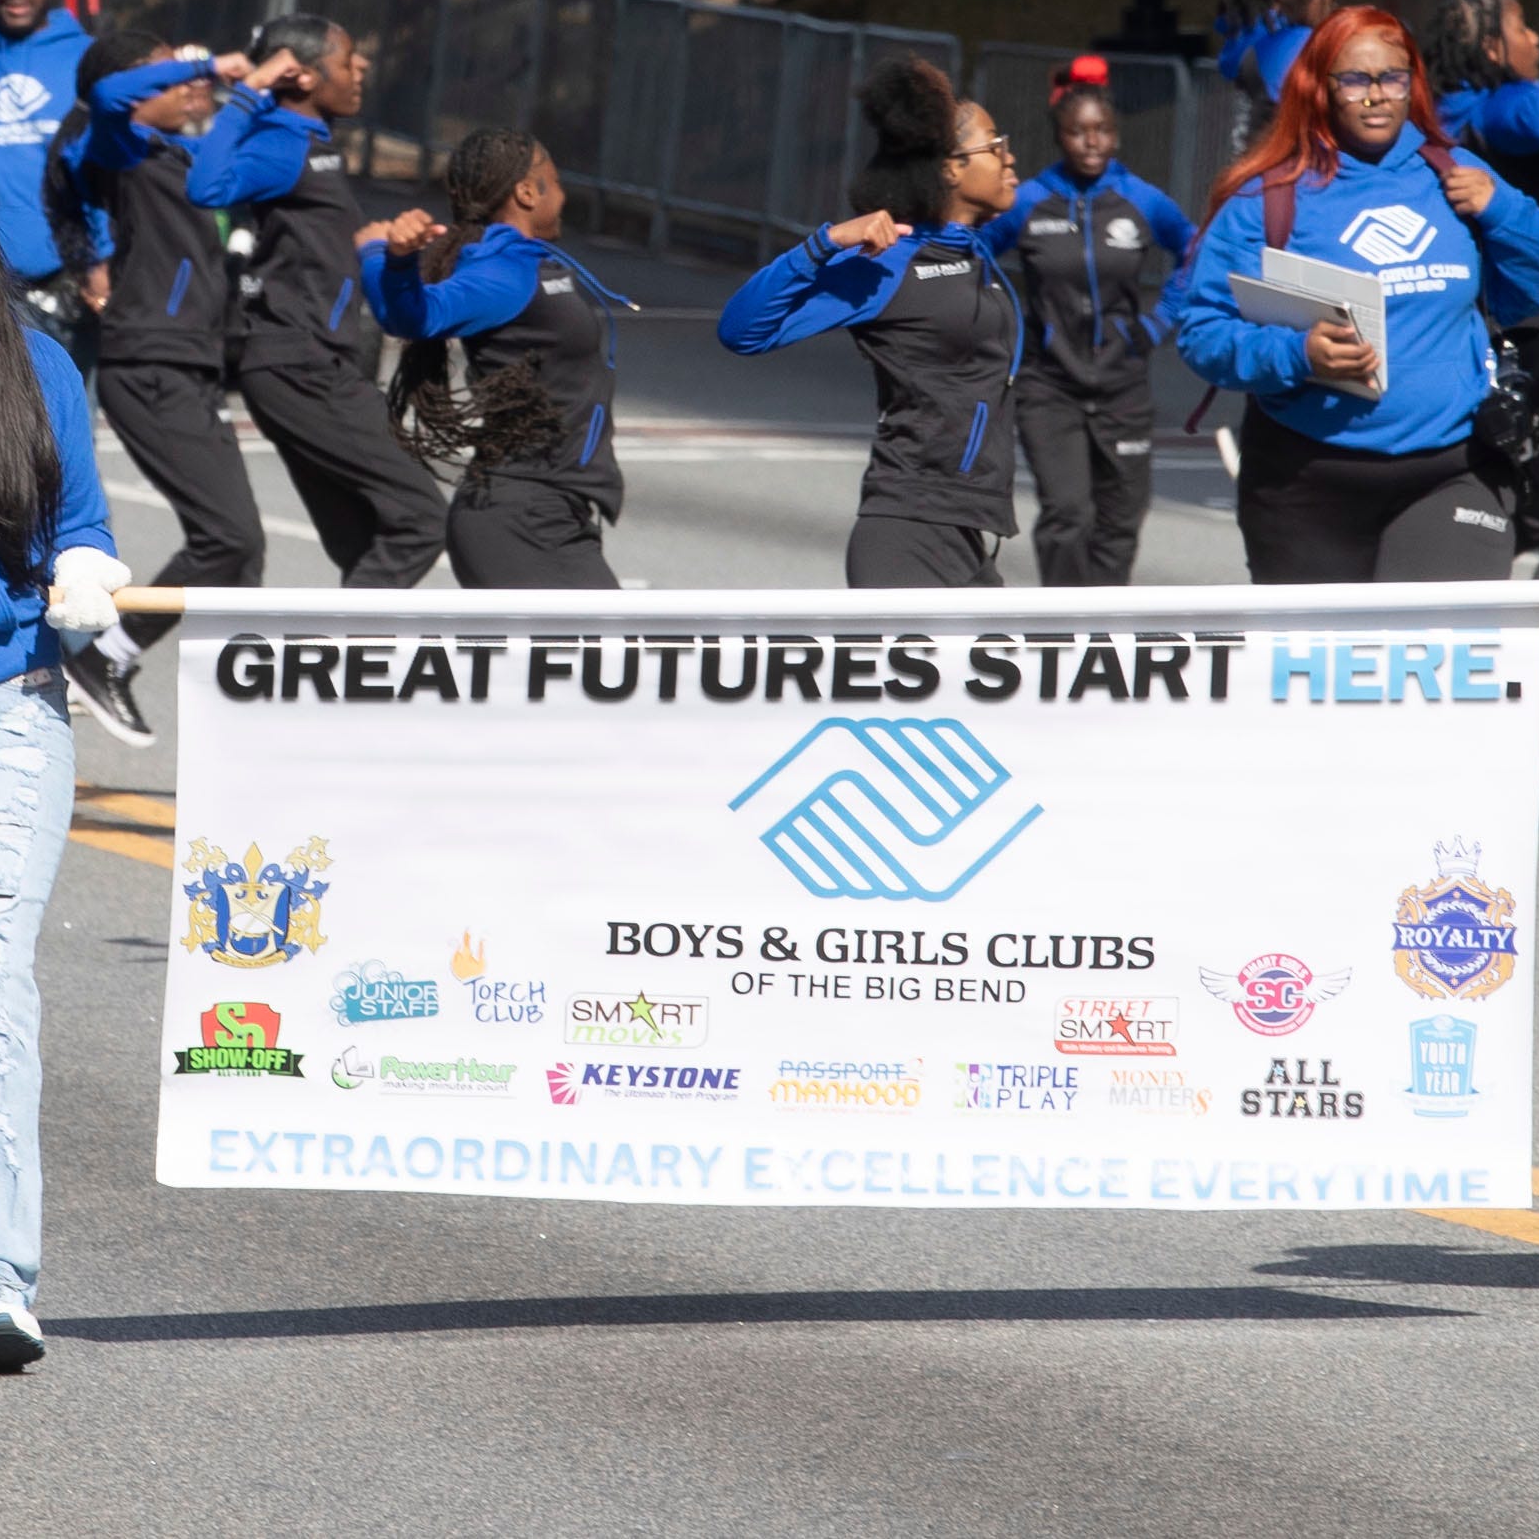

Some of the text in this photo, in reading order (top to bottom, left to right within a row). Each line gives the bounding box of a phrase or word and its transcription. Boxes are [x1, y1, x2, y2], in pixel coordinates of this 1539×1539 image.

[215, 628, 1523, 703] GREAT FUTURES START HERE.
[606, 921, 1156, 970] BOYS & GIRLS CLUBS
[1399, 923, 1512, 950] ROYALTY
[348, 982, 439, 1002] JUNIOR
[463, 976, 548, 1004] TORCH
[731, 971, 1027, 1004] OF THE BIG BEND
[1245, 979, 1304, 1009] SG
[359, 997, 439, 1017] STAFF
[474, 1001, 545, 1024] CLUB
[1061, 998, 1154, 1018] STREET
[571, 1024, 683, 1046] moves
[1419, 1040, 1466, 1066] YOUTH
[581, 1063, 742, 1090] KEYSTONE
[778, 1060, 908, 1081] PASSPORT
[996, 1064, 1080, 1089] TRIPLE
[1111, 1070, 1189, 1087] MONEY
[1264, 1058, 1341, 1086] ALL
[1424, 1071, 1460, 1095] YEAR
[996, 1089, 1079, 1111] PLAY
[1109, 1086, 1214, 1117] MATTERS
[1240, 1089, 1364, 1119] STARS
[209, 1129, 1491, 1204] EXTRAORDINARY EXCELLENCE EVERYTIME
